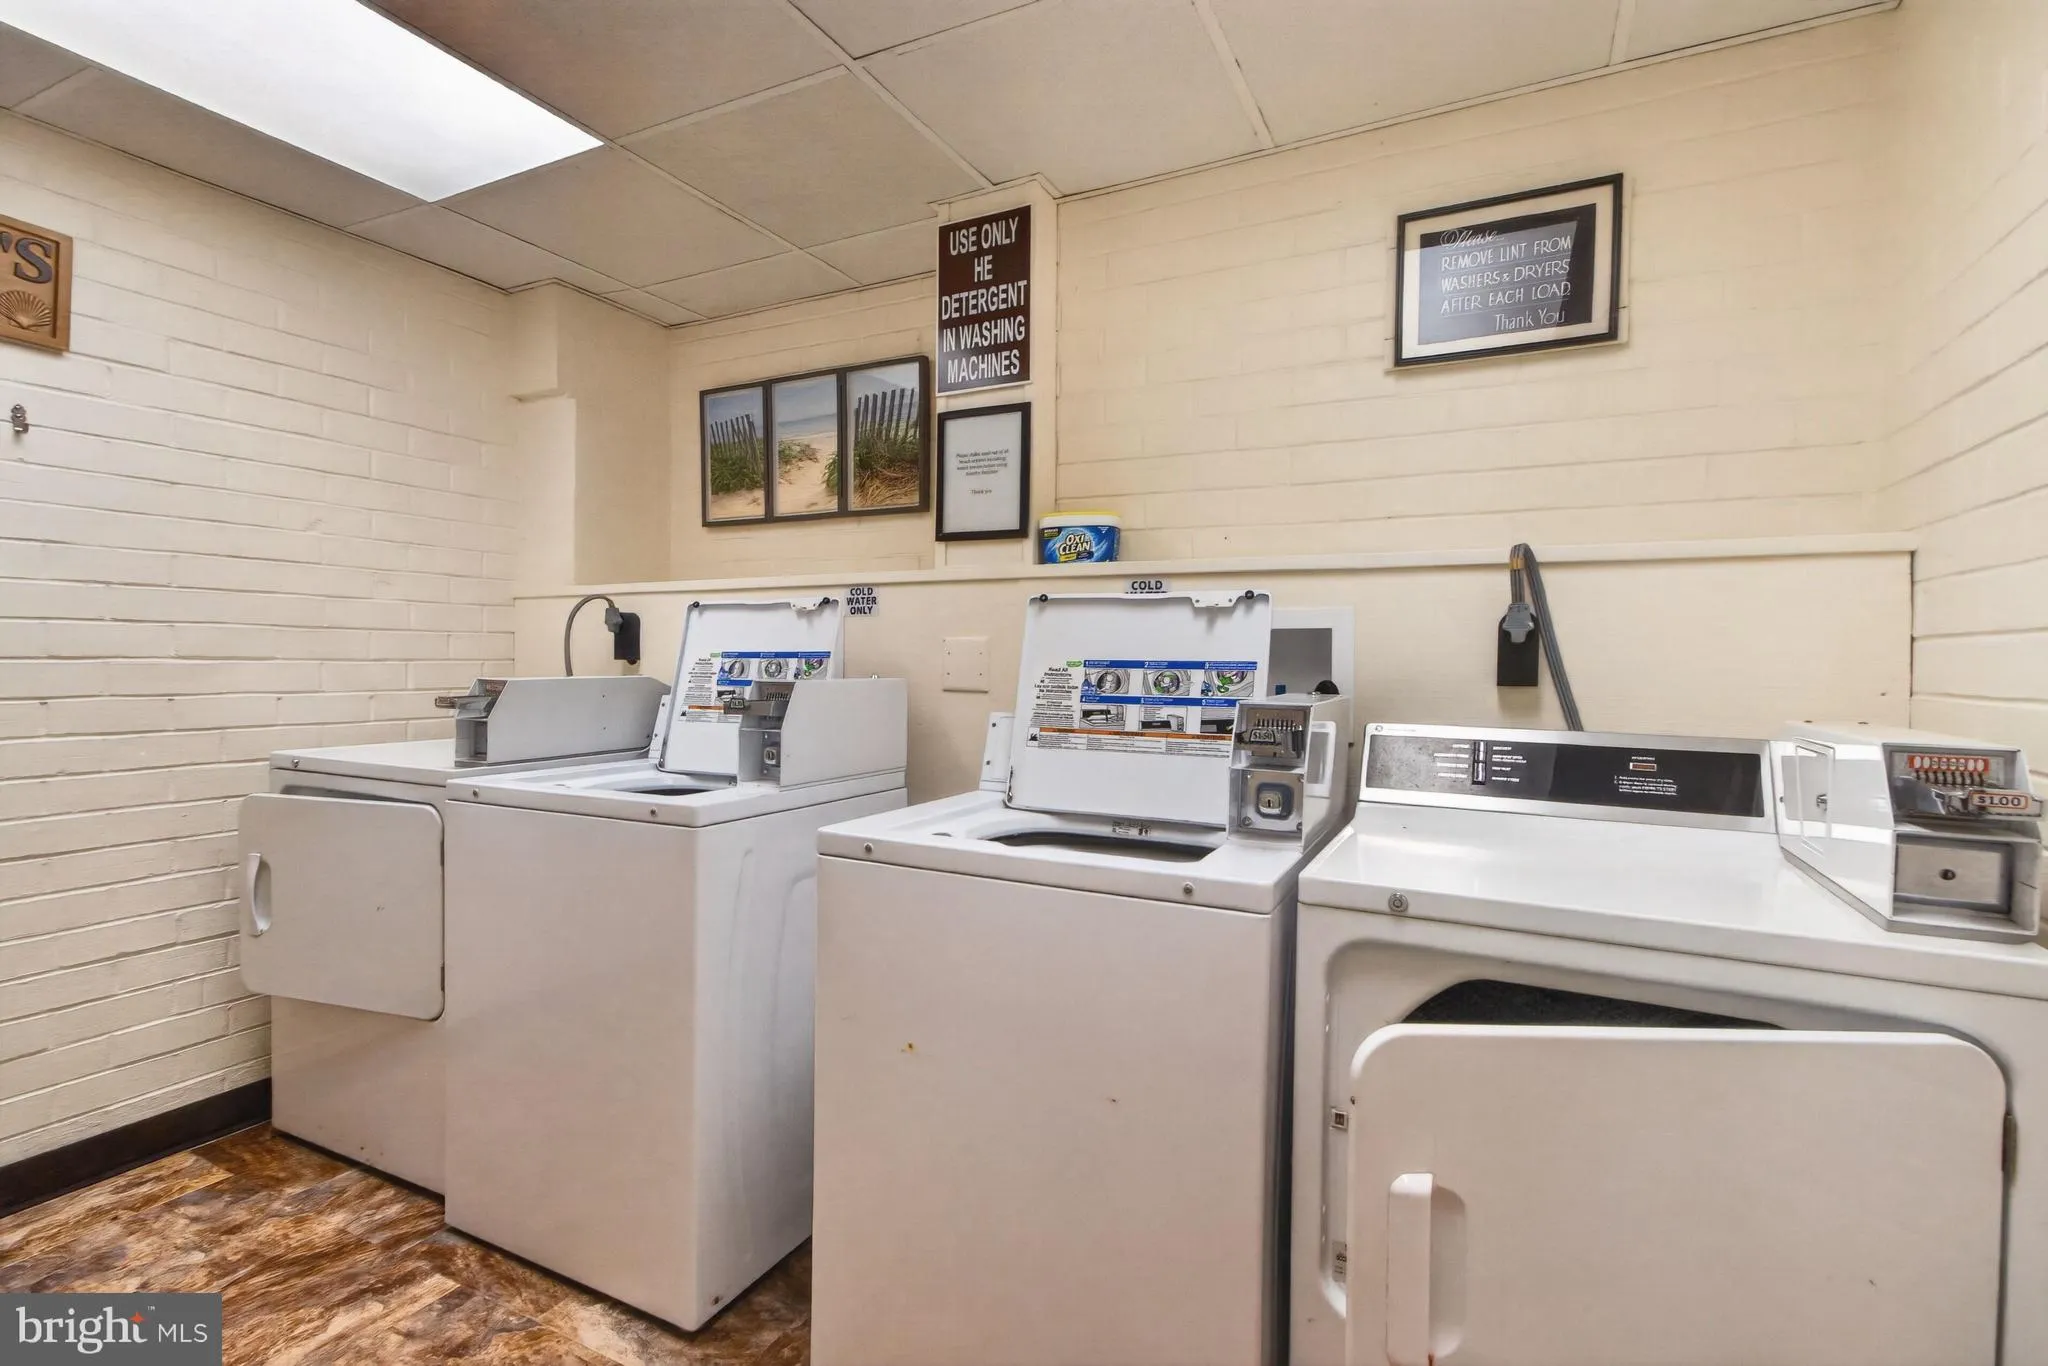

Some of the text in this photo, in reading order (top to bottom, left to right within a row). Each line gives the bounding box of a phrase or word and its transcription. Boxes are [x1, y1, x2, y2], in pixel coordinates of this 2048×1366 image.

[950, 216, 1019, 256] USE ONLY
[1441, 235, 1571, 272] REMOVE LINT FROM
[974, 255, 993, 283] HE
[1441, 271, 1500, 294] WASHERS
[1514, 259, 1571, 281] DRYERS
[942, 280, 1027, 320] DETERGENT
[1441, 295, 1482, 316] AFTER
[1489, 288, 1524, 306] EACH
[943, 315, 1026, 353] IN WASHING
[1495, 309, 1565, 332] Thank You
[947, 349, 1020, 384] MACHINES
[1060, 541, 1091, 555] CLEAN
[1066, 533, 1086, 545] OXI
[850, 587, 874, 596] COLD
[1131, 580, 1163, 591] COLD
[846, 596, 877, 606] WATER
[850, 606, 873, 615] ONLY
